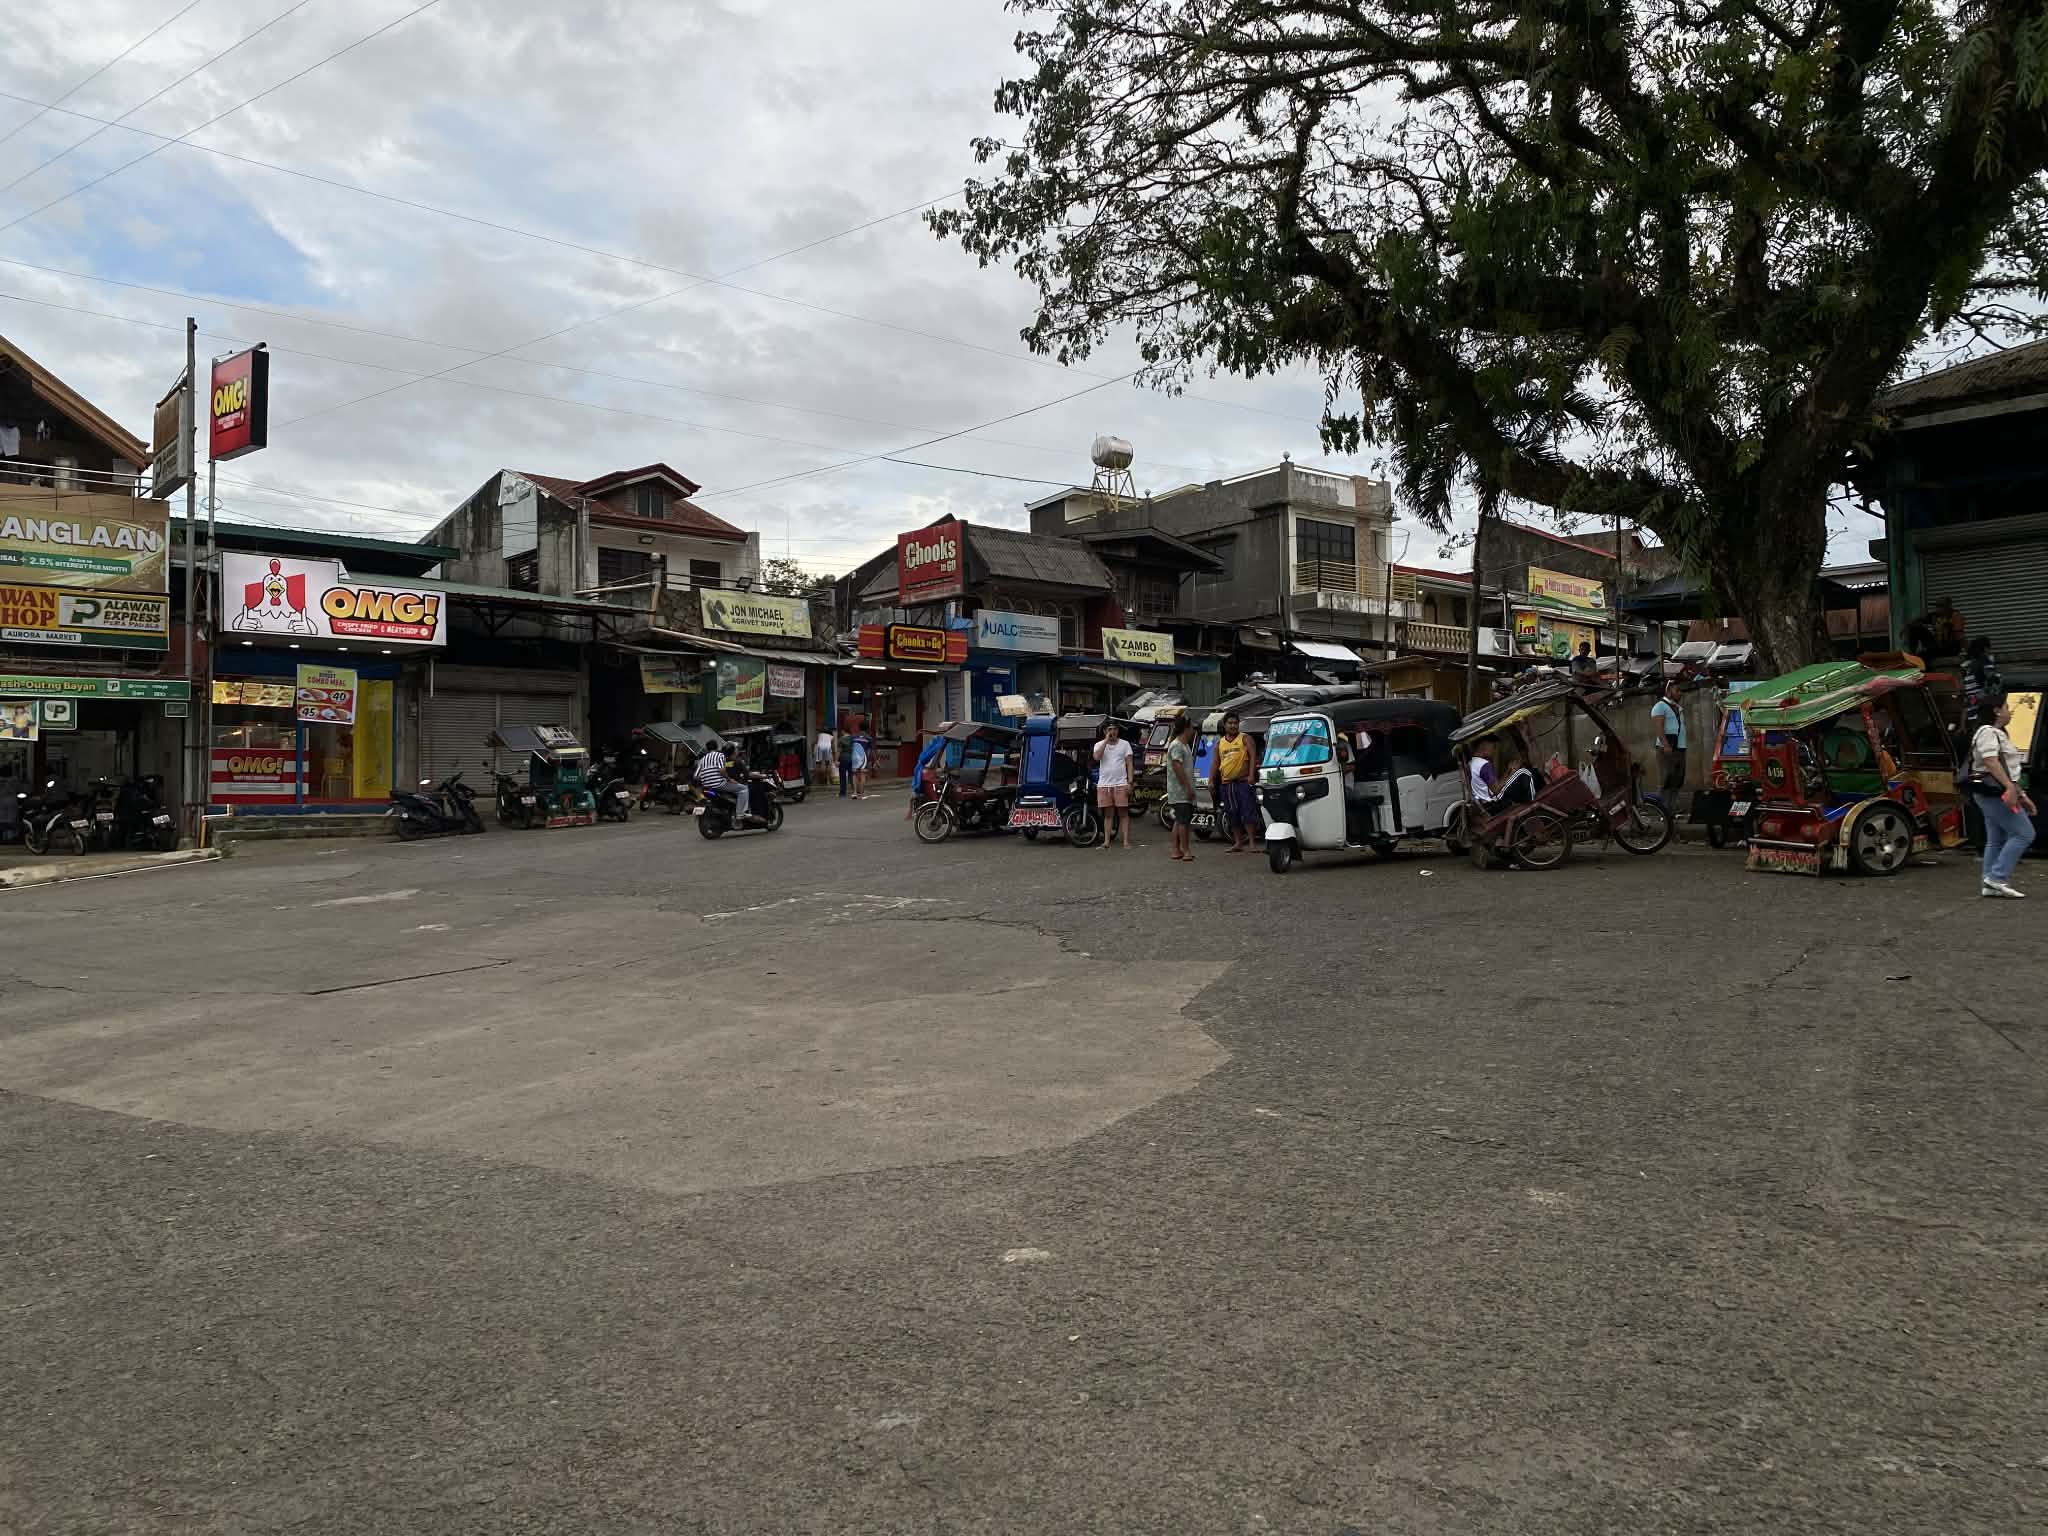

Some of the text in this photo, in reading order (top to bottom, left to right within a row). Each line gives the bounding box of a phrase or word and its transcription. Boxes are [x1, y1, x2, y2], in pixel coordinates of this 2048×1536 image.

[213, 376, 248, 417] OMG!
[905, 536, 956, 569] Chooks
[0, 588, 56, 609] WAN
[320, 586, 440, 626] OMG!
[1, 607, 56, 627] HOP
[103, 610, 161, 623] EXPRESS
[730, 604, 784, 622] JON MICHAEL
[731, 617, 784, 629] AGRIVET SUPPLY
[7, 631, 77, 641] AURORA MARKET
[896, 633, 925, 648] Chooks
[1120, 639, 1157, 652] ZAMBO
[1127, 650, 1152, 658] STORE
[63, 682, 96, 692] Bayan
[307, 677, 329, 685] COMBO
[332, 692, 346, 701] 40
[302, 707, 315, 717] 45
[228, 755, 285, 775] OMG!
